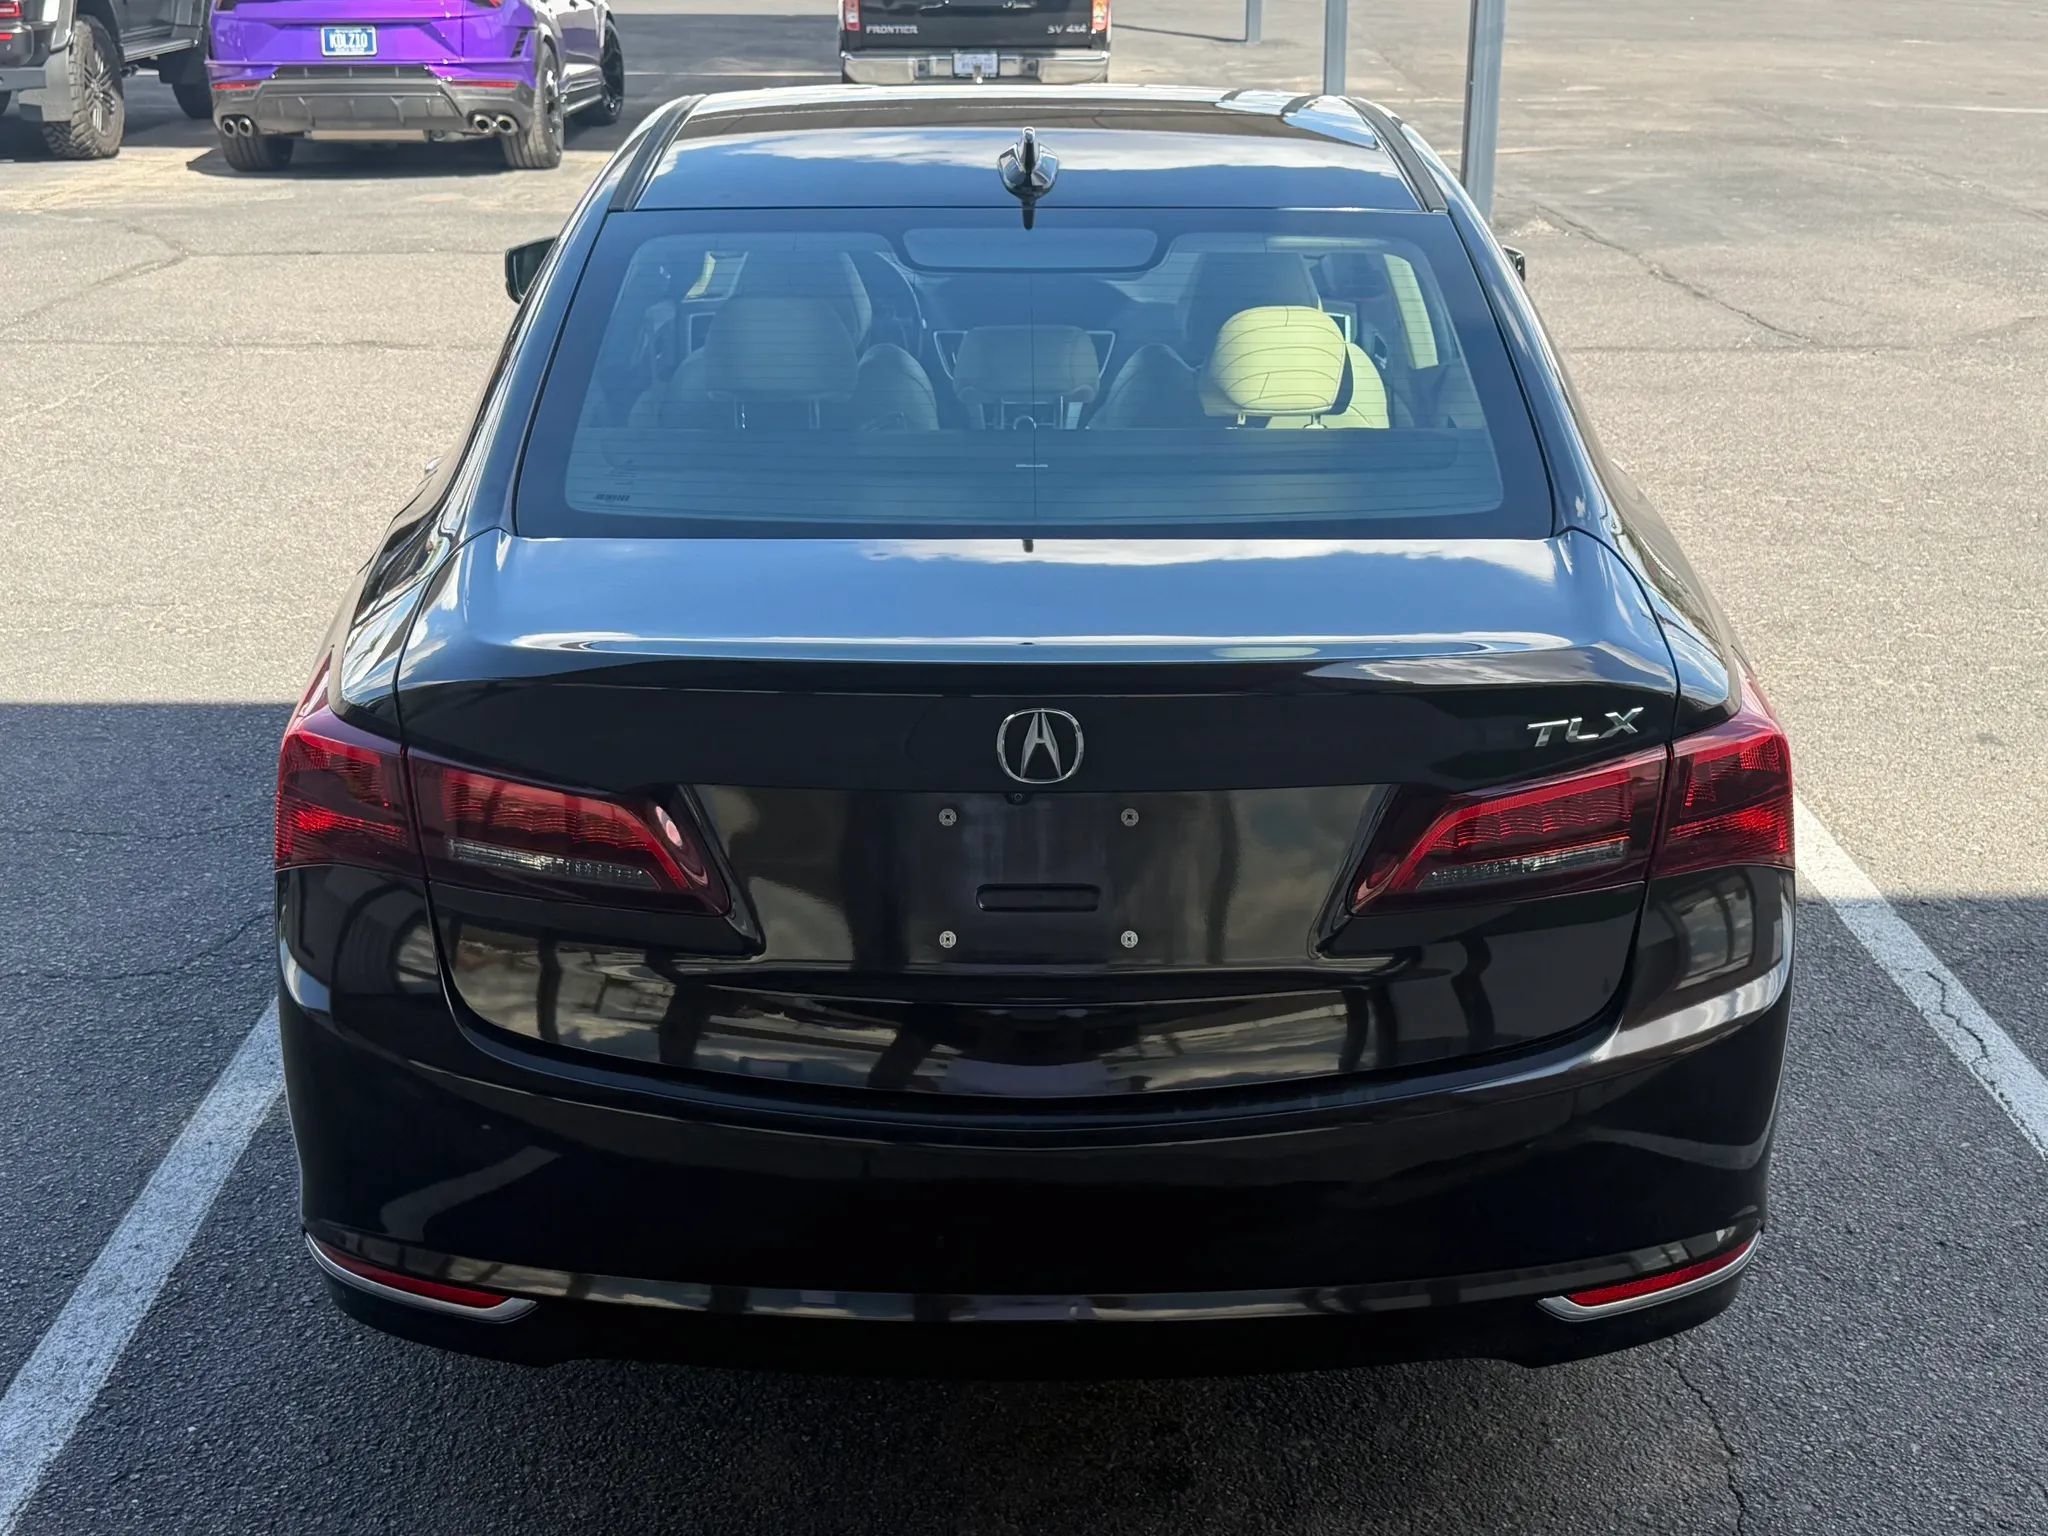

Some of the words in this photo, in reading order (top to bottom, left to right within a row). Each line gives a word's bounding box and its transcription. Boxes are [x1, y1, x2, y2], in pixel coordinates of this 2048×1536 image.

[866, 25, 918, 34] FRONTIER
[1047, 25, 1063, 34] SV
[1527, 706, 1644, 747] TLX
